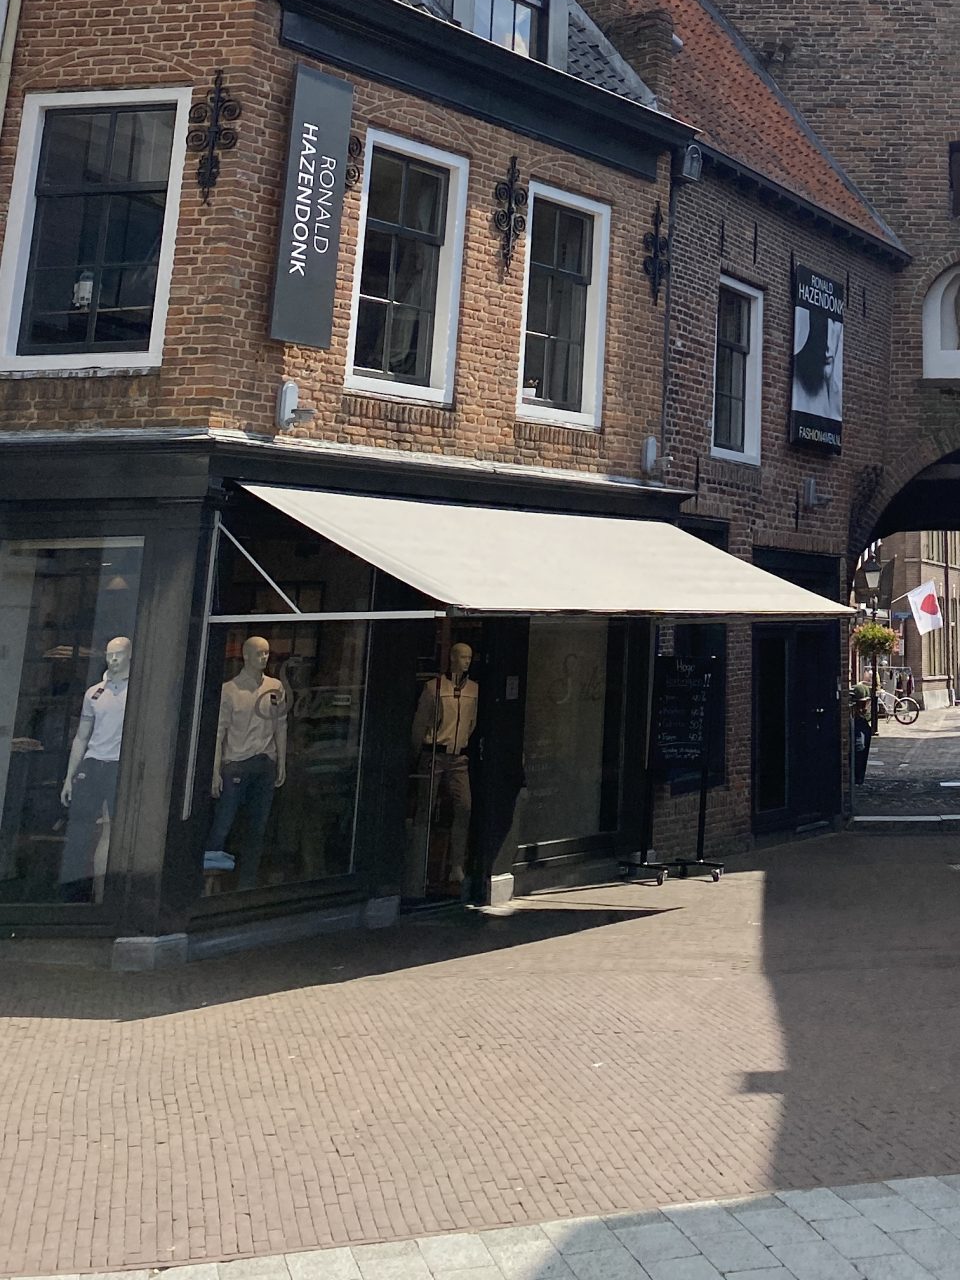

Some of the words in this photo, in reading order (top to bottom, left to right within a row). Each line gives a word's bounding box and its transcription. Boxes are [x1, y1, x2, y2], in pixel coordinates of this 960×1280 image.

[288, 122, 319, 277] HAZENDONK
[313, 155, 337, 254] RONALD
[799, 282, 844, 315] HAZENDONK
[811, 275, 834, 294] RONALD
